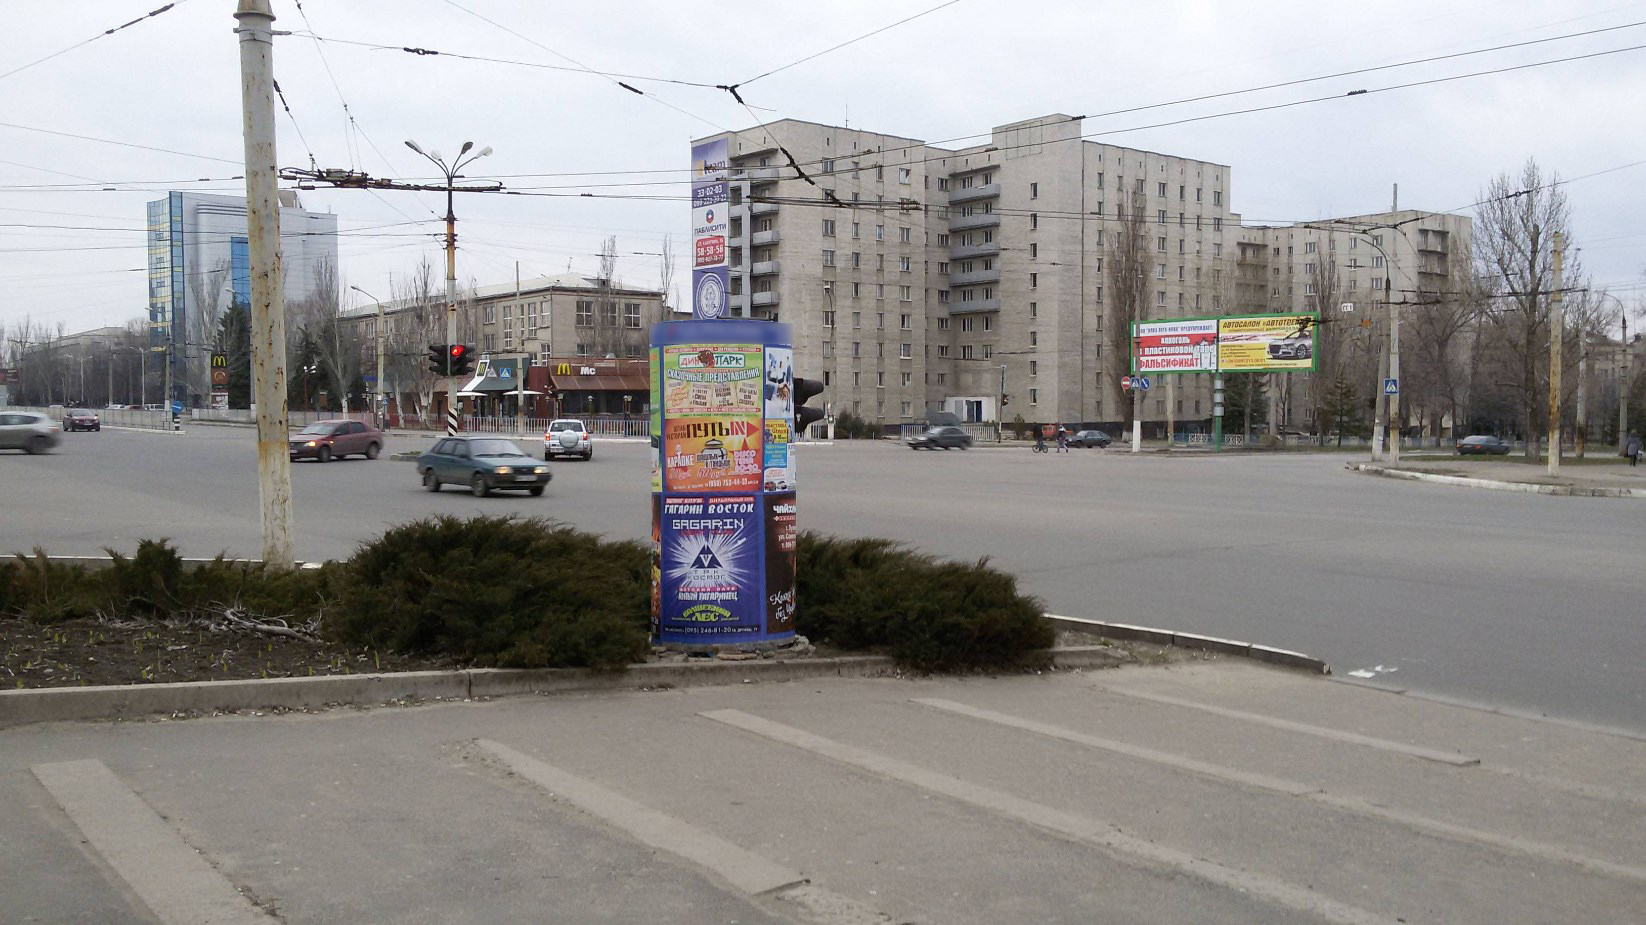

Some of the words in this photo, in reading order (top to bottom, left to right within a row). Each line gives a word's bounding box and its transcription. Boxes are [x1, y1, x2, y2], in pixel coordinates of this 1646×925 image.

[1222, 320, 1261, 328] АВТОСАЛОН
[667, 368, 703, 382] СКАЗОЧНЫЕ
[704, 367, 760, 382] ПРЕДСТАВЛЕНИЯ
[665, 505, 703, 514] ГАГАРИН
[708, 504, 754, 514] ВОСТОК
[672, 518, 744, 529] GAGARIN
